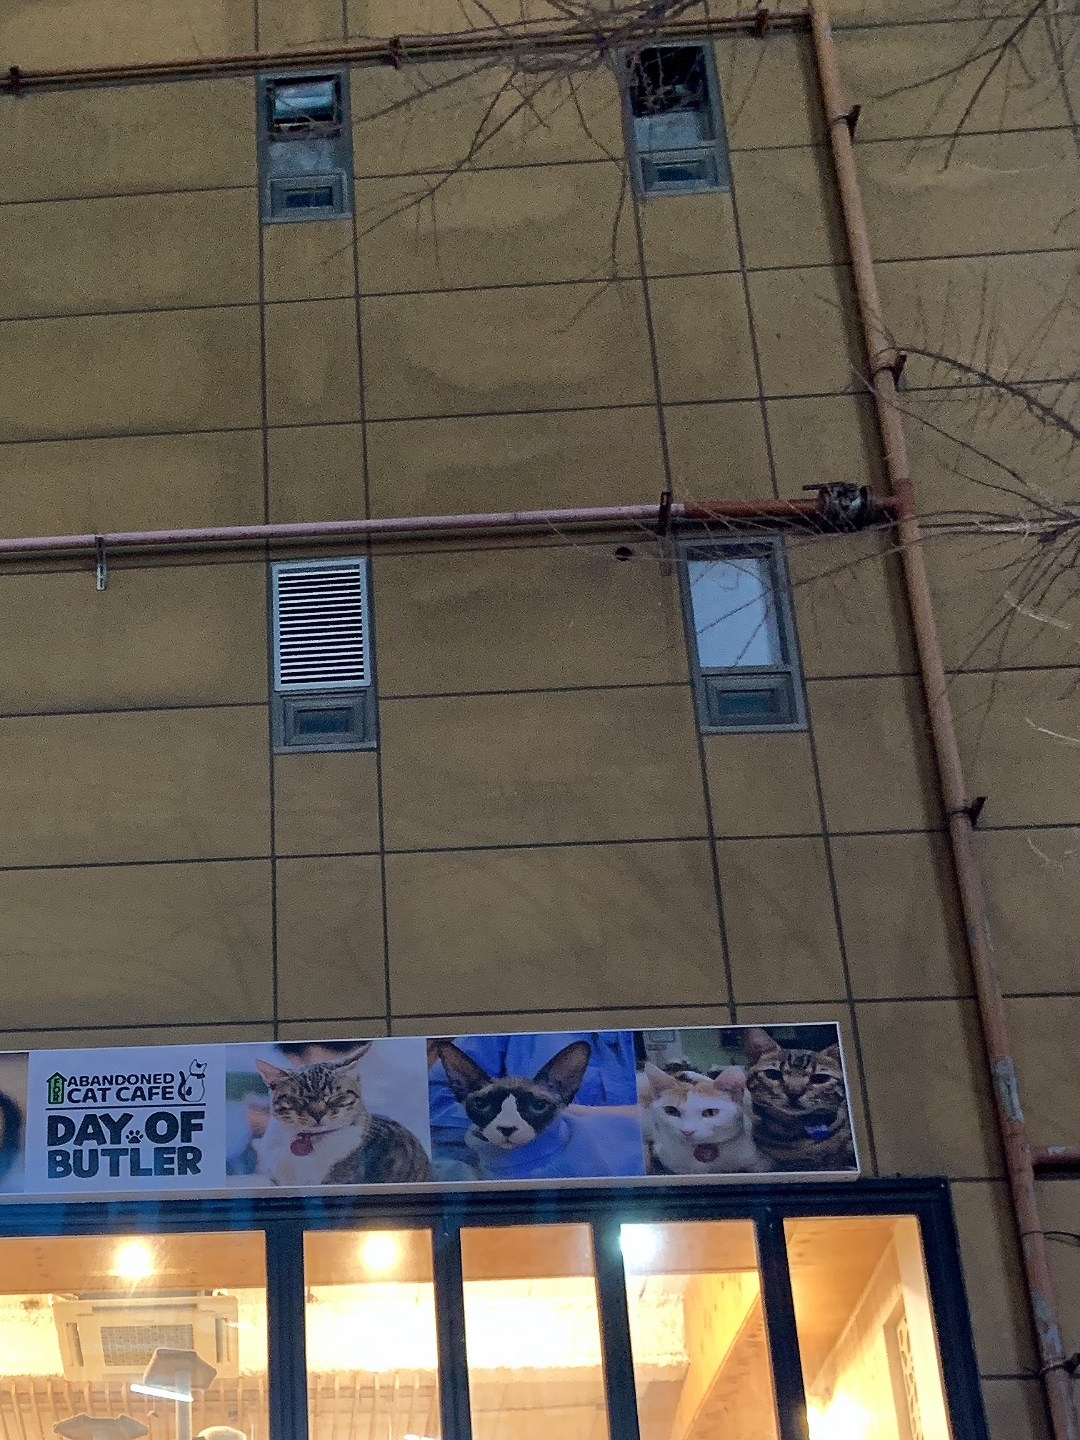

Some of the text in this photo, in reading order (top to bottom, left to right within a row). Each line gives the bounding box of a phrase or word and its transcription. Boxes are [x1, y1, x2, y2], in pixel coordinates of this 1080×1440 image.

[67, 1073, 174, 1087] ABANDONED
[67, 1086, 174, 1104] CAT CAFE
[47, 1111, 205, 1146] DAY OF
[48, 1146, 202, 1179] BUTLER
